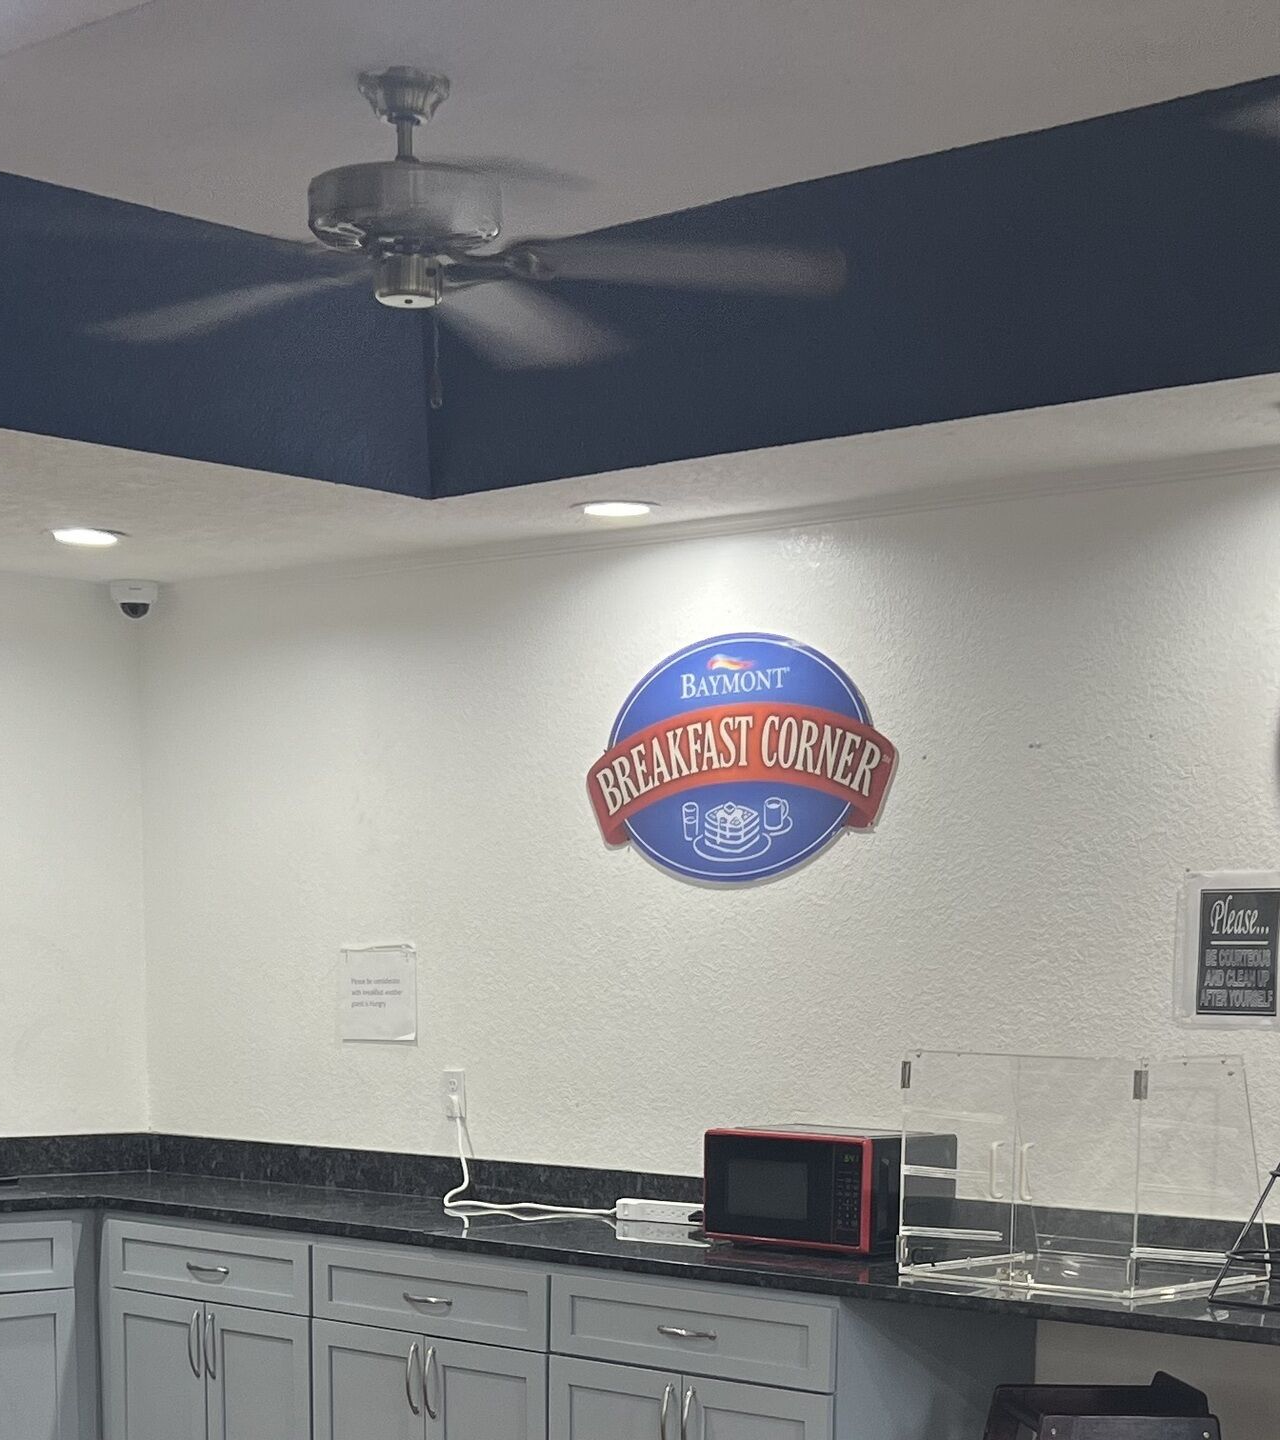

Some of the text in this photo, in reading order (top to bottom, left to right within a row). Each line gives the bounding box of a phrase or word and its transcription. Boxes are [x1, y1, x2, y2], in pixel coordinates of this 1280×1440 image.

[680, 667, 786, 700] BAYMONT
[596, 714, 881, 816] BREAKFAST CORNER
[1210, 895, 1269, 935] Please...
